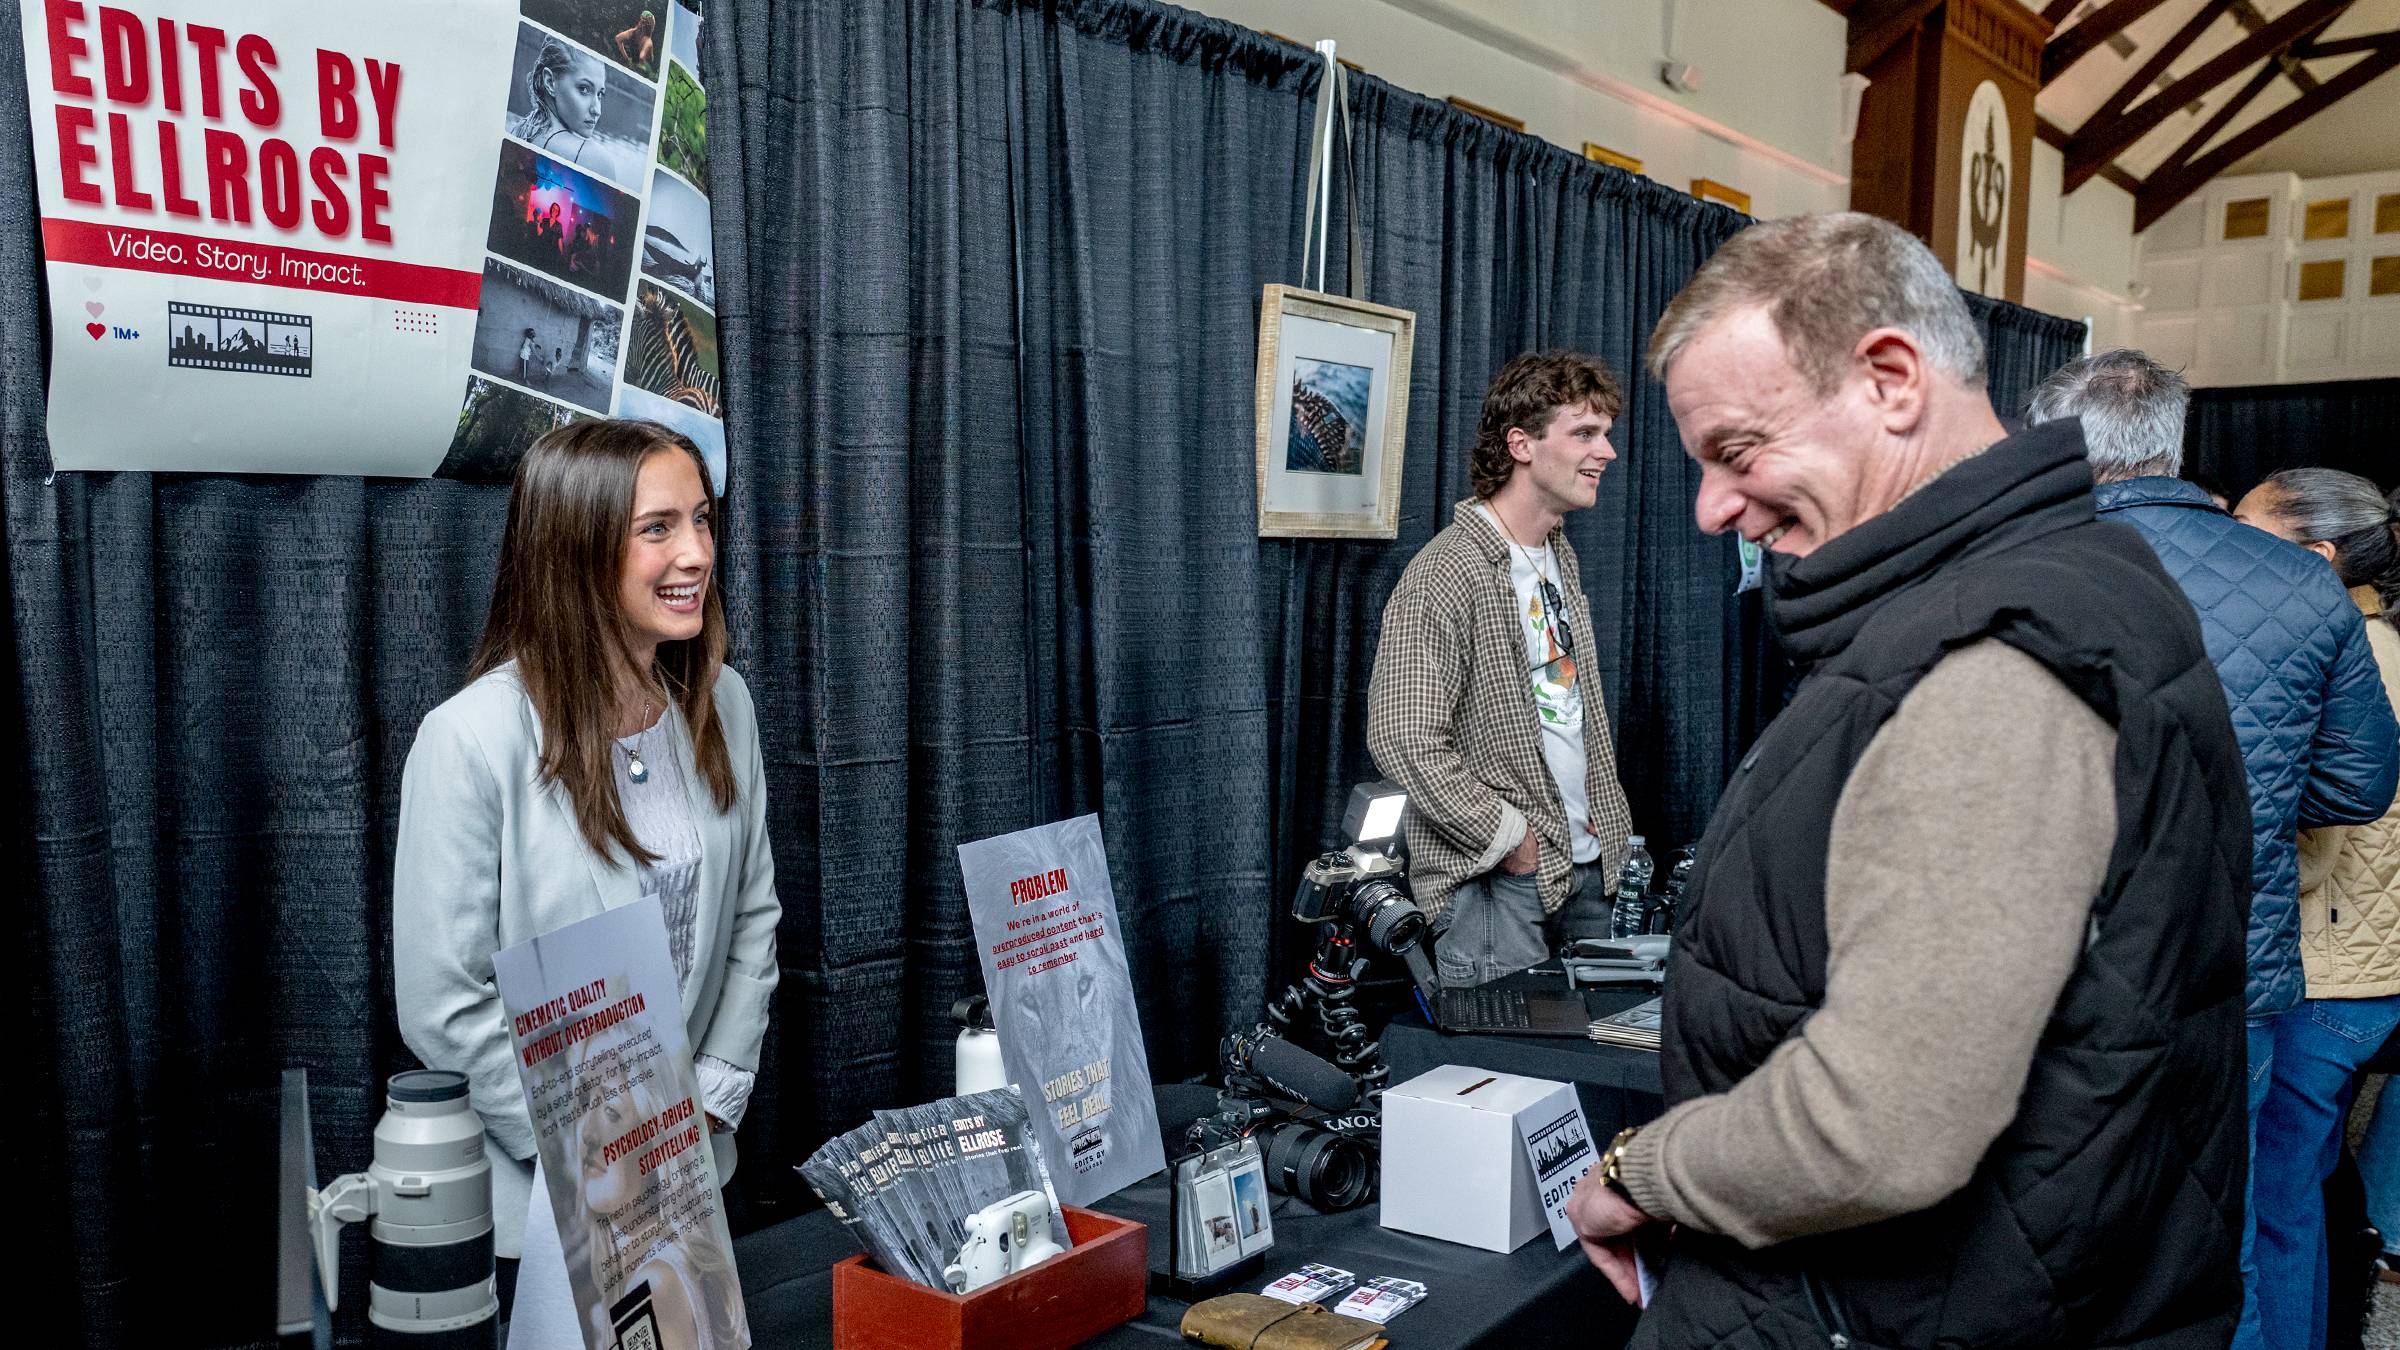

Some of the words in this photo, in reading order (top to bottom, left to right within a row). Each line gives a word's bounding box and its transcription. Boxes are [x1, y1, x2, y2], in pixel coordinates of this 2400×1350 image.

[44, 0, 280, 127] EDITS
[316, 48, 401, 148] BY
[55, 103, 392, 243] ELLROSE
[107, 231, 189, 265] Video.
[196, 243, 273, 280] Story.
[280, 253, 367, 287] Impact.
[112, 326, 141, 341] 1M+
[1010, 868, 1069, 906] PROBLEM
[992, 927, 1045, 954] overproduced
[1046, 919, 1078, 936] content
[1078, 911, 1103, 925] that's
[1006, 917, 1031, 932] We're
[1031, 914, 1040, 924] in
[1041, 913, 1047, 921] a
[1047, 904, 1070, 919] world
[1072, 900, 1081, 912] of
[996, 957, 1015, 970] easy
[1016, 952, 1025, 963] to
[1026, 943, 1050, 959] scroll
[1050, 937, 1069, 953] past
[1069, 932, 1084, 944] and
[1084, 925, 1105, 940] hard
[1027, 965, 1037, 975] to
[515, 996, 567, 1037] CINEMATIC
[568, 978, 607, 1013] QUALITY
[522, 1030, 564, 1068] WITHOUT
[565, 992, 646, 1046] OVERPRODUCTION
[531, 1069, 575, 1099] End-to-end
[1044, 1069, 1084, 1104] STORIES
[1084, 1058, 1111, 1086] THAT
[602, 1096, 695, 1167] PSYCHOLOGY-DRIVEN
[952, 1117, 975, 1132] EDITS
[973, 1115, 985, 1128] BY
[1057, 1102, 1082, 1130] FEEL
[1324, 1115, 1381, 1131] SONY
[639, 1124, 701, 1176] STORYTELLING
[958, 1129, 1006, 1153] ELLROSE
[1074, 1155, 1094, 1170] EDITS
[1096, 1149, 1106, 1159] BY
